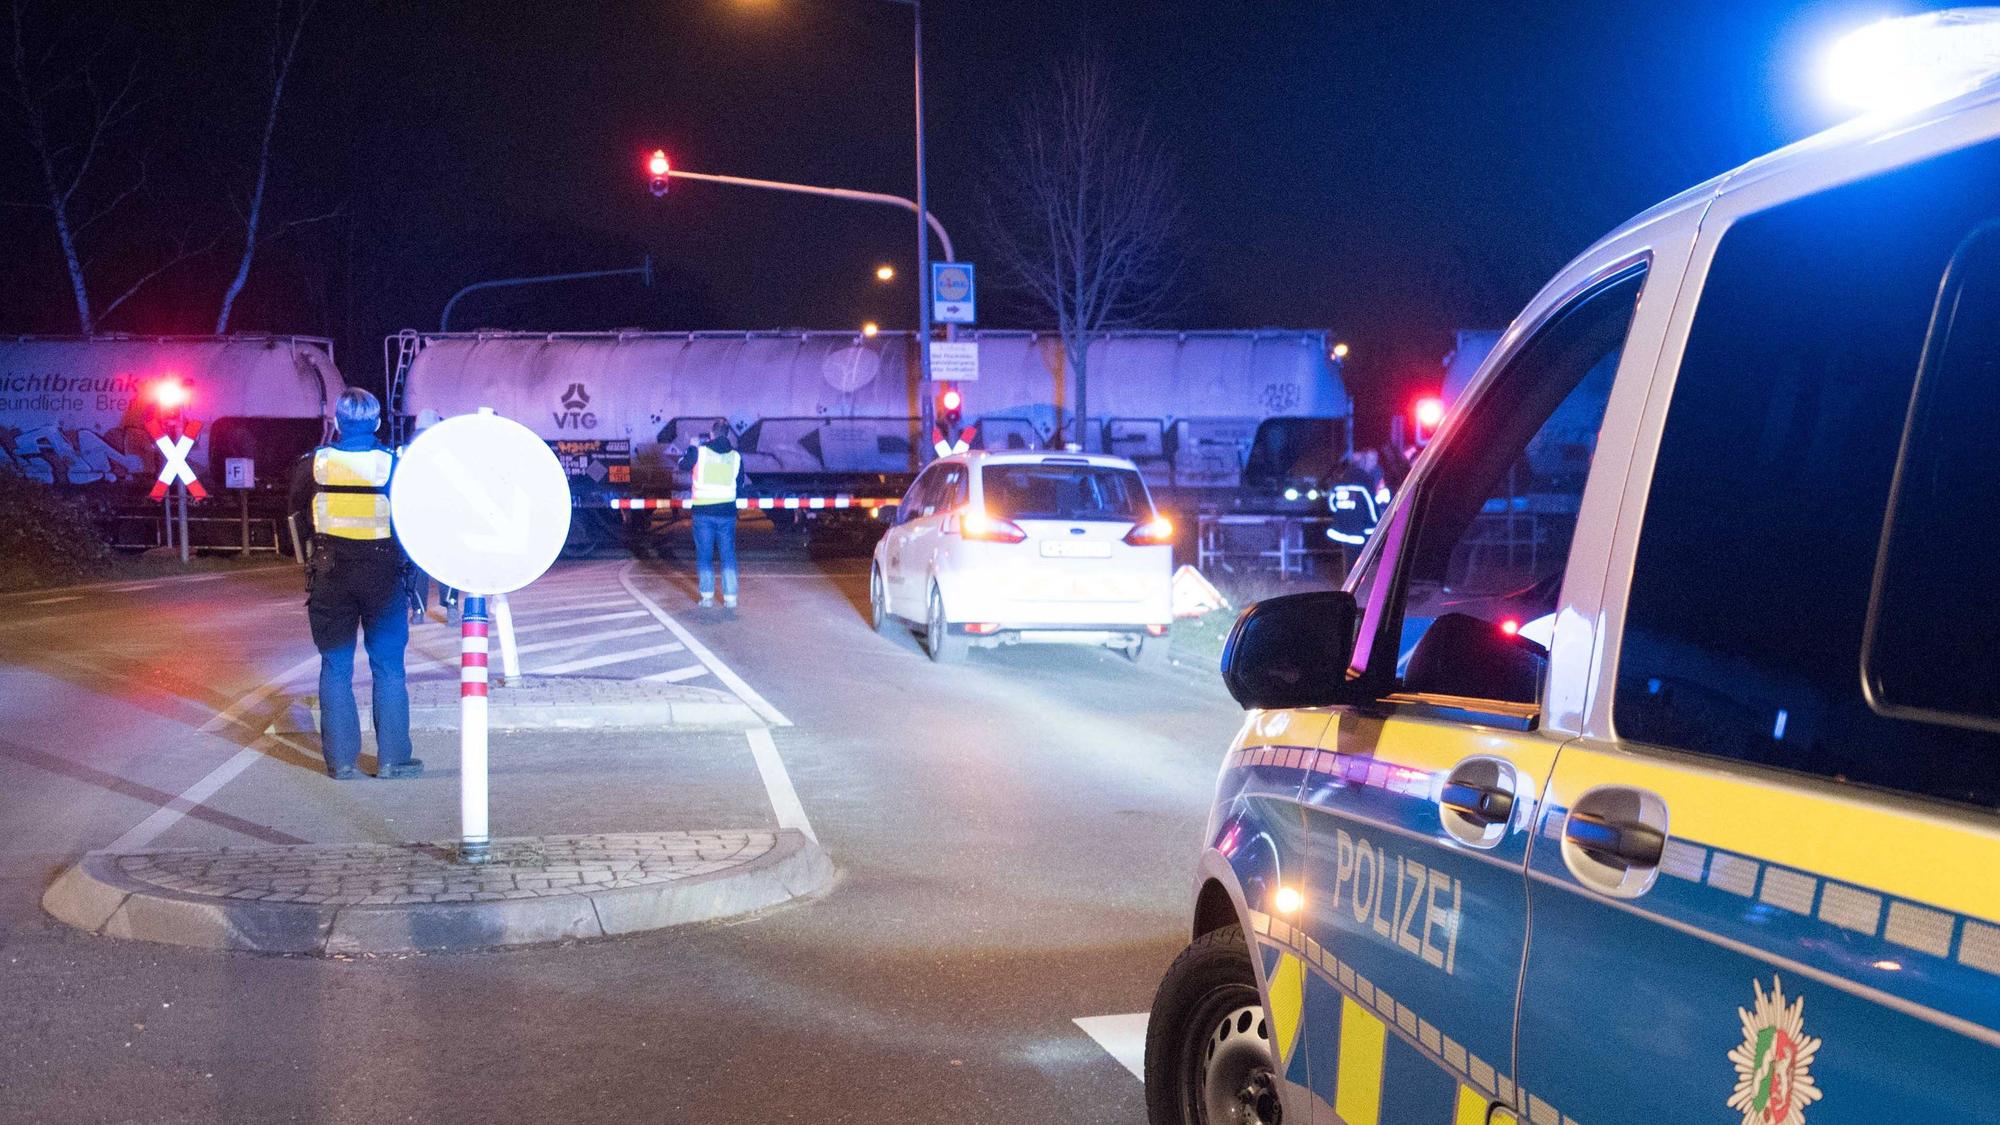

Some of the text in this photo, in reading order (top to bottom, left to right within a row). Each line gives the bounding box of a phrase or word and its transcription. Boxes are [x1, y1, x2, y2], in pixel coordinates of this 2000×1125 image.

[553, 412, 597, 430] VTG
[233, 466, 241, 478] F
[1333, 828, 1461, 975] POLIZEI
